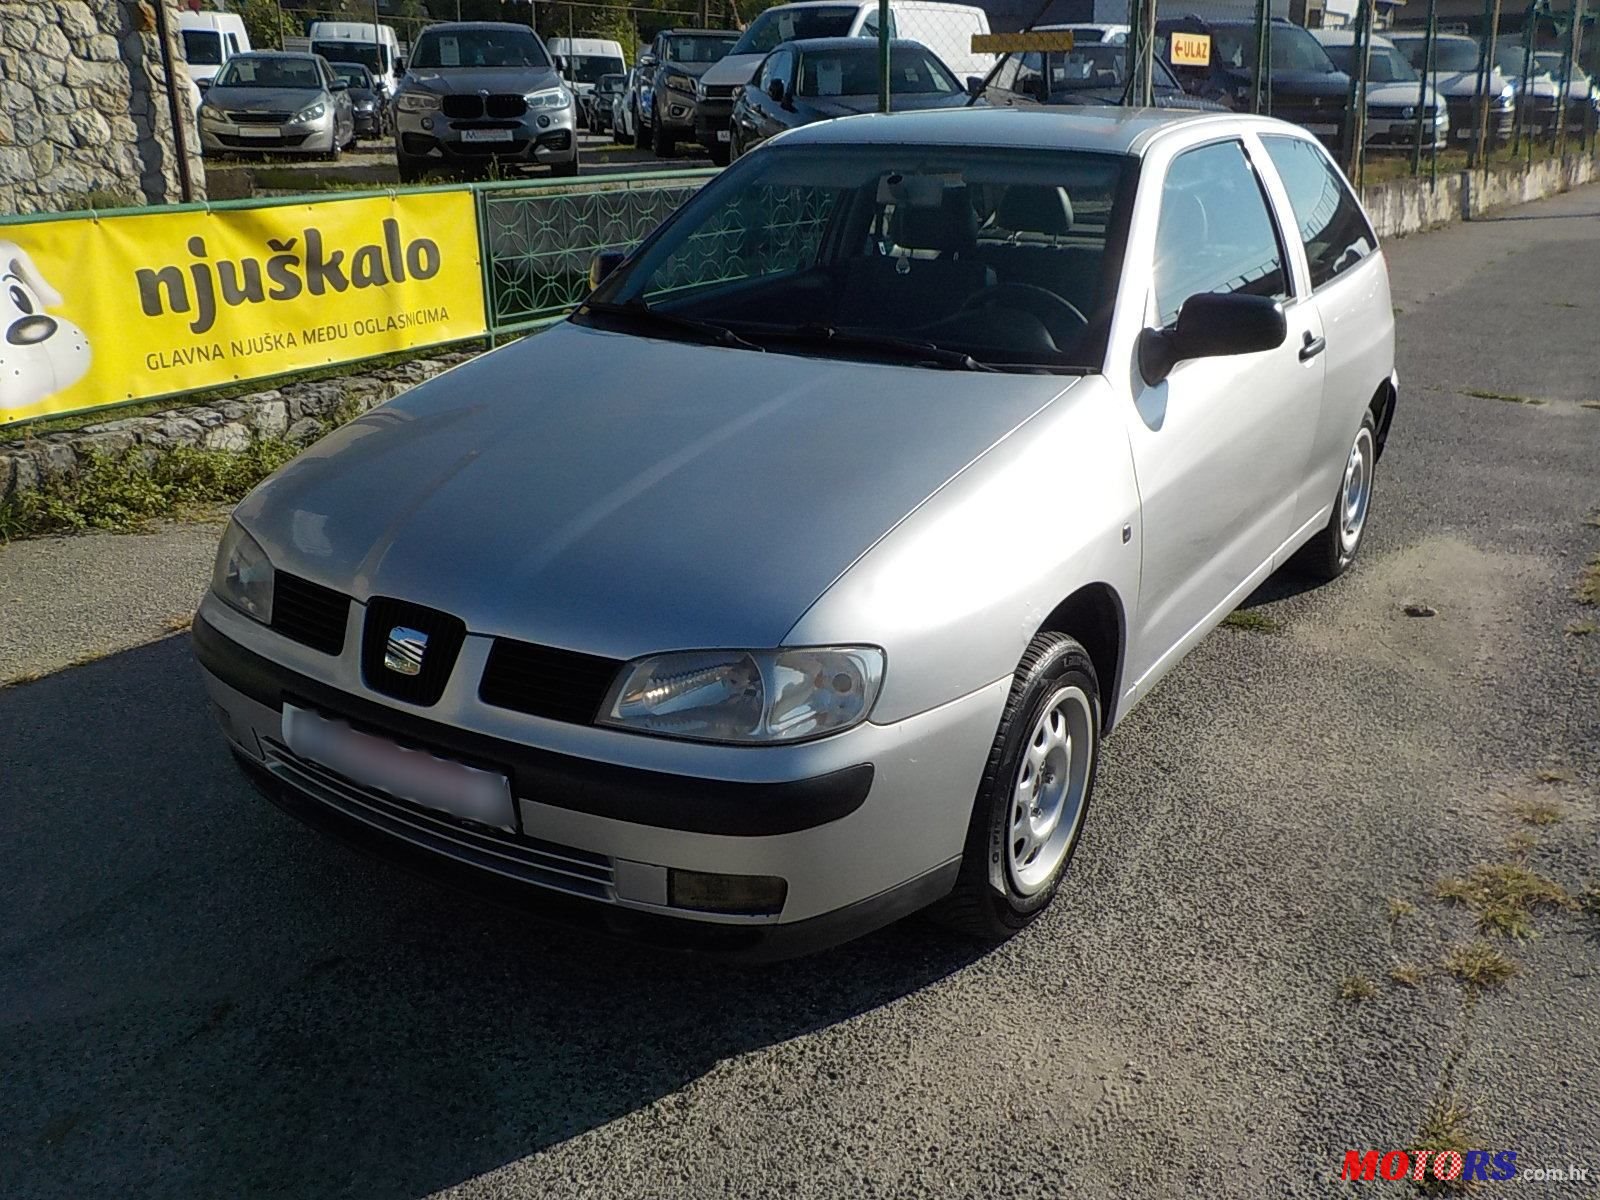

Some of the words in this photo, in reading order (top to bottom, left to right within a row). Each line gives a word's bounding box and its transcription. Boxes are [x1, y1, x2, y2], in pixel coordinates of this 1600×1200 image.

[1184, 41, 1207, 58] ULAZ
[135, 218, 441, 334] njuškalo
[146, 343, 225, 371] GLAVNA
[231, 332, 297, 357] NJUŠKA
[353, 306, 449, 336] OGLASNICIMA
